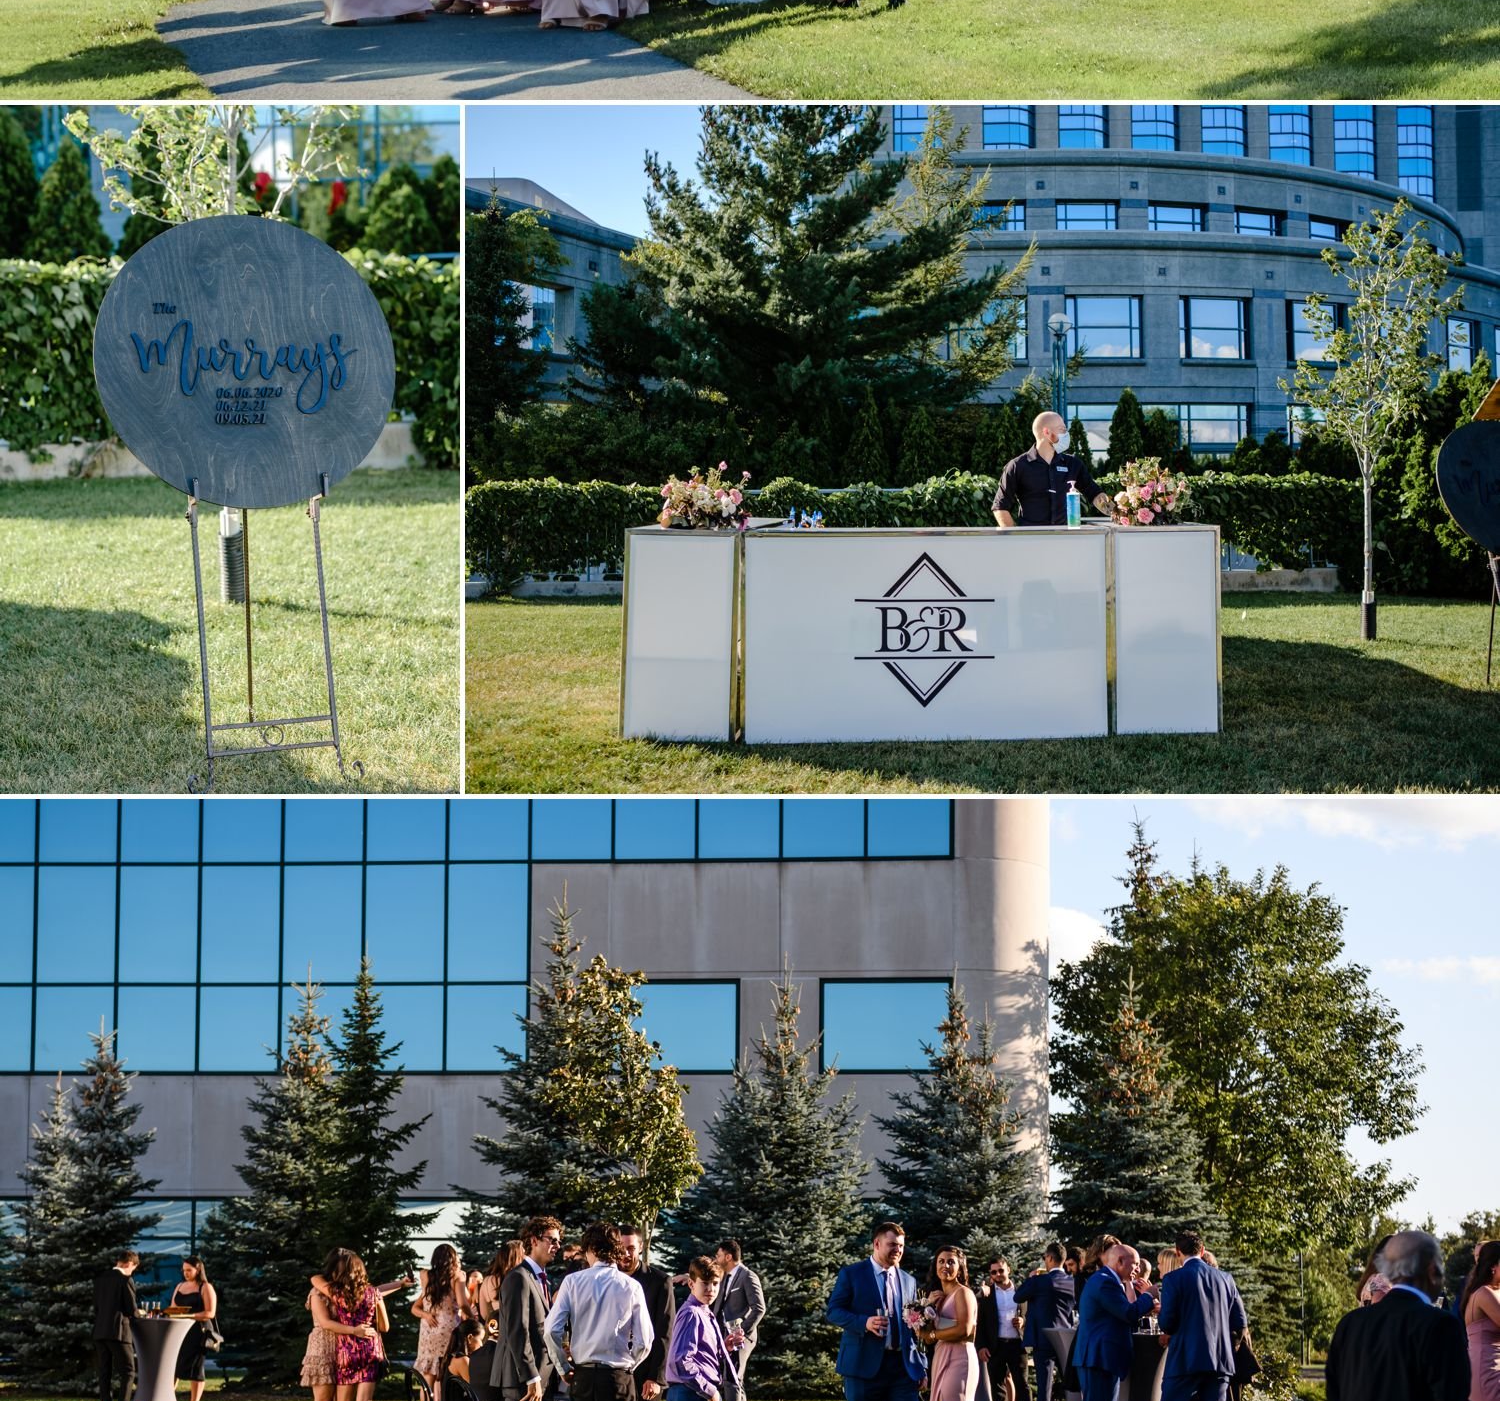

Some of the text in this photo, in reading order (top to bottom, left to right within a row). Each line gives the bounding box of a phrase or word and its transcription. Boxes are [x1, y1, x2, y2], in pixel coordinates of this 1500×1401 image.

[152, 302, 177, 315] The
[130, 319, 358, 414] Murrays
[215, 386, 283, 399] 06.06.2020
[215, 400, 267, 412] 06.12.21
[215, 412, 267, 425] 09.05.21
[874, 606, 974, 653] B&R
